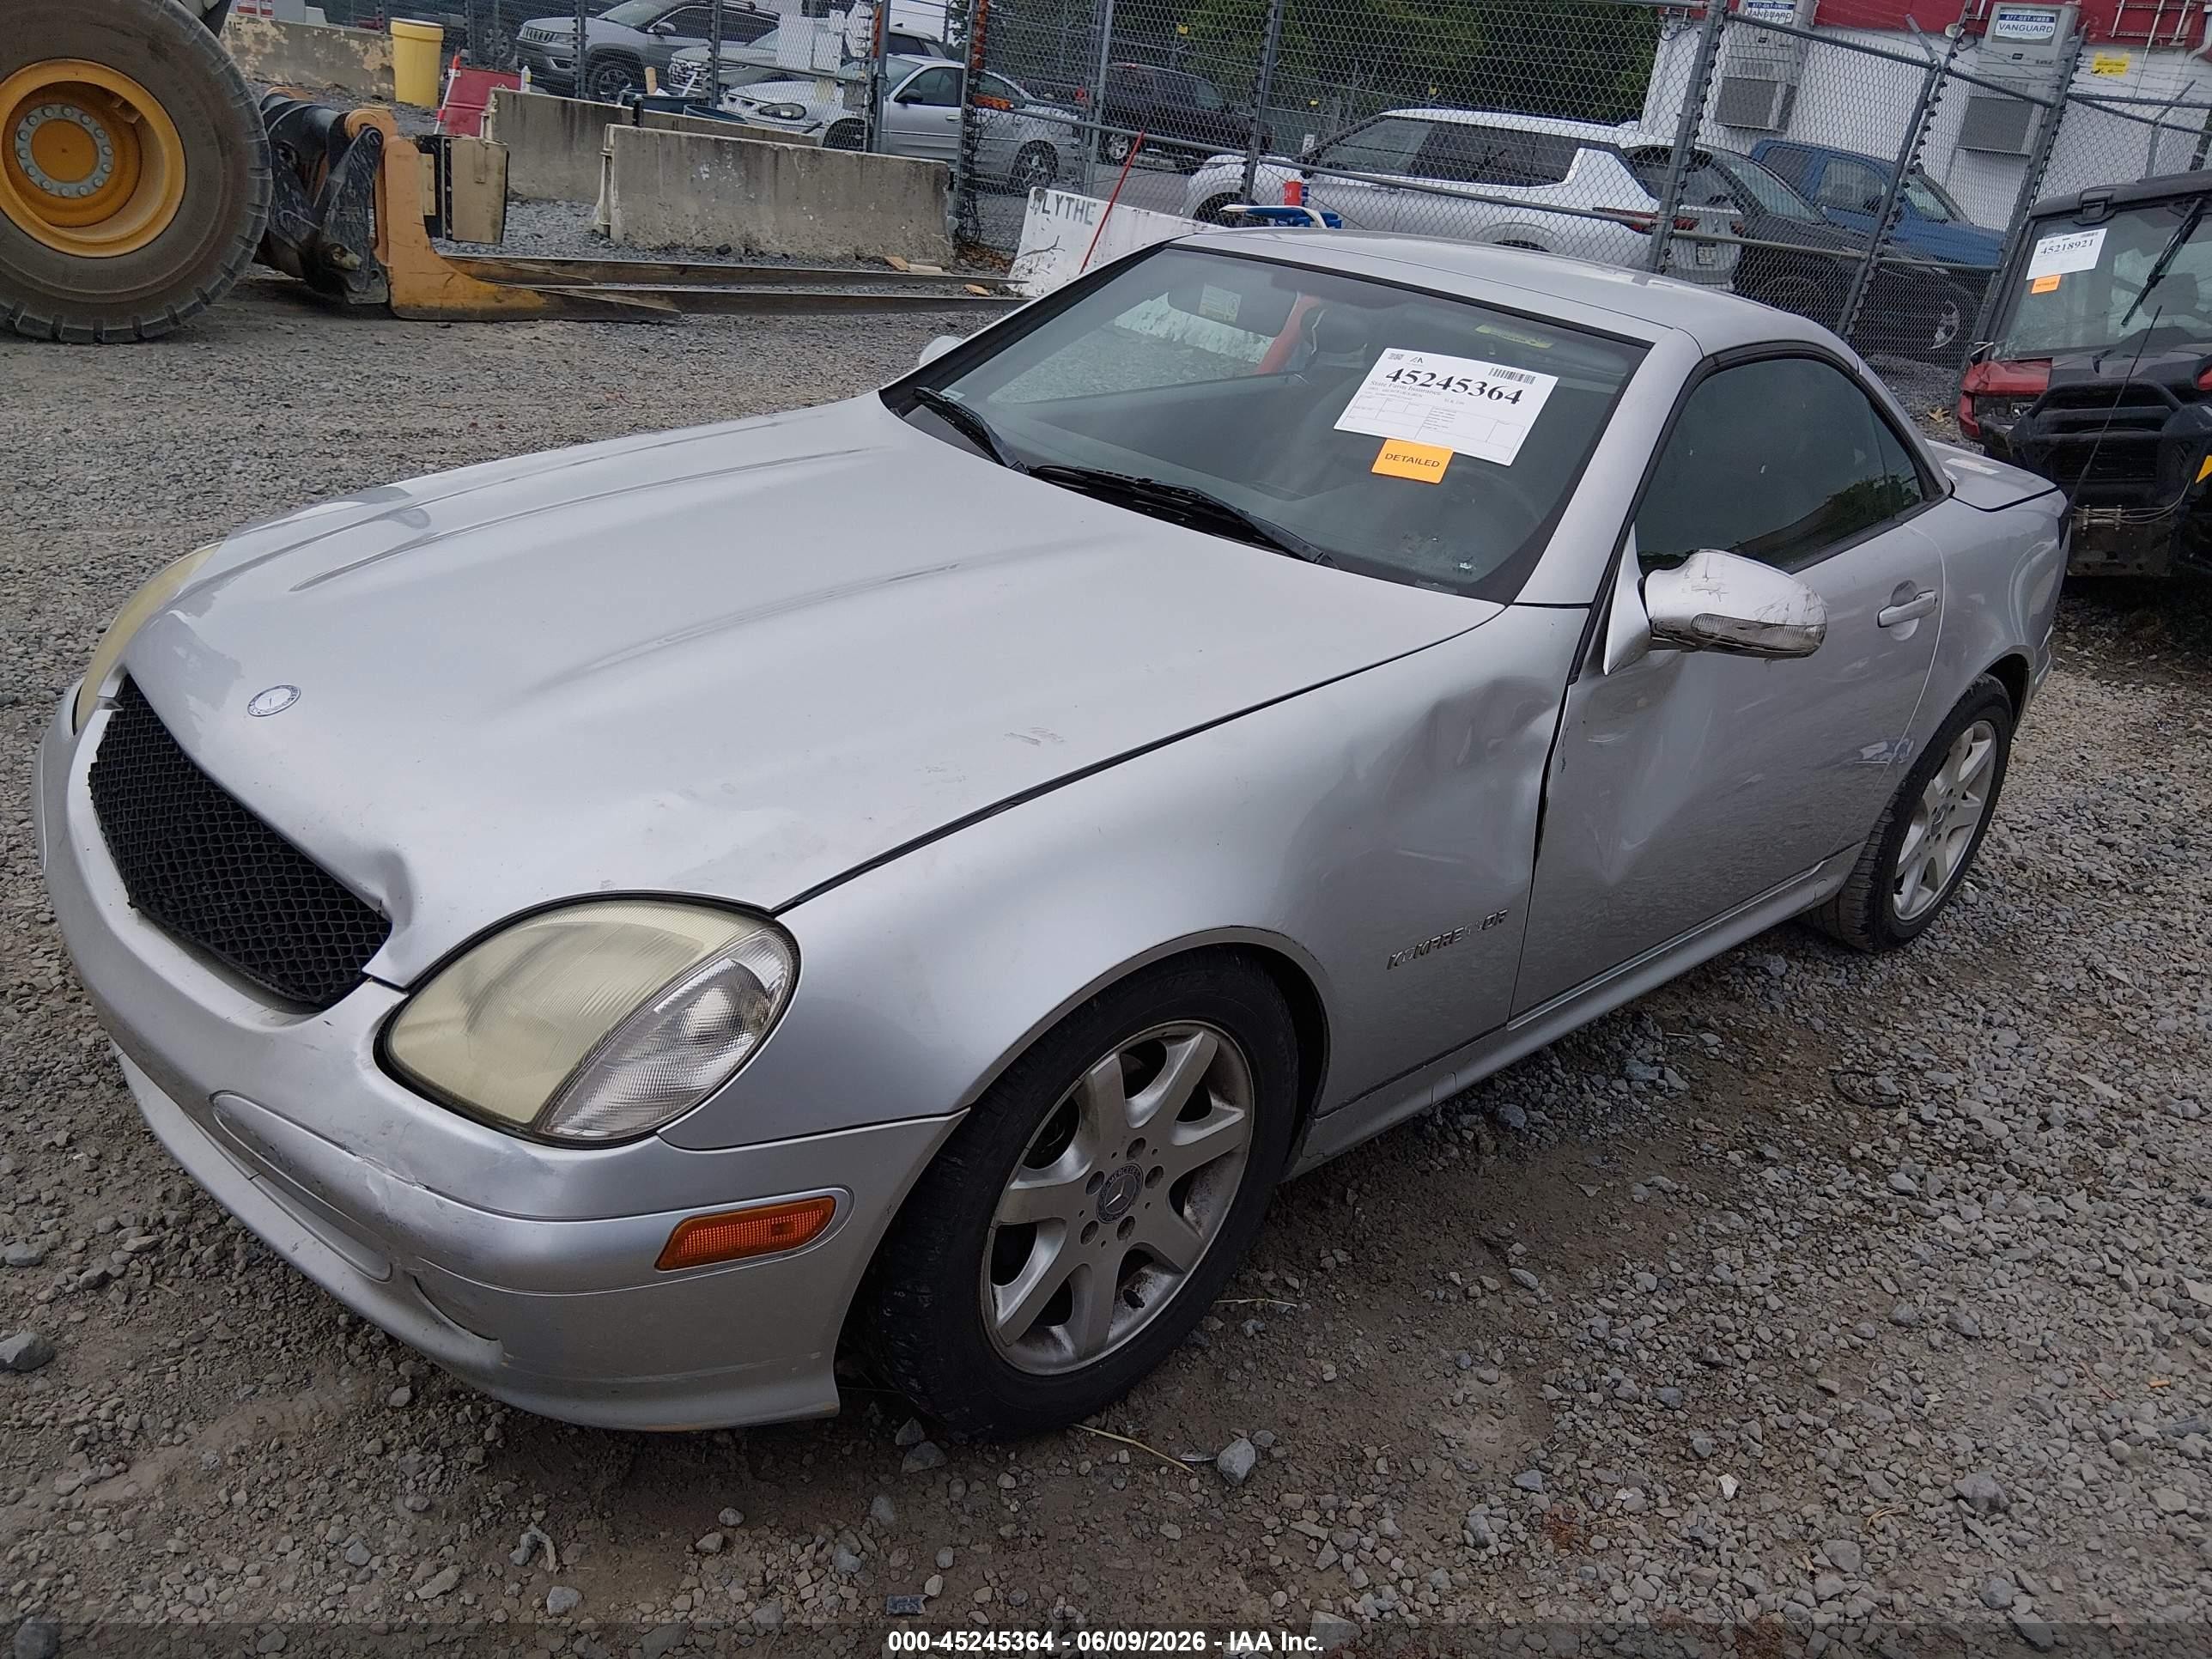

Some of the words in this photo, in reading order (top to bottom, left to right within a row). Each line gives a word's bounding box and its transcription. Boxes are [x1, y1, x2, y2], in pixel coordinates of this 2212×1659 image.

[1999, 22, 2053, 33] VANGUARD
[2040, 240, 2093, 254] 45218921
[1386, 368, 1522, 404] 45245364
[1384, 453, 1440, 468] DETAILED
